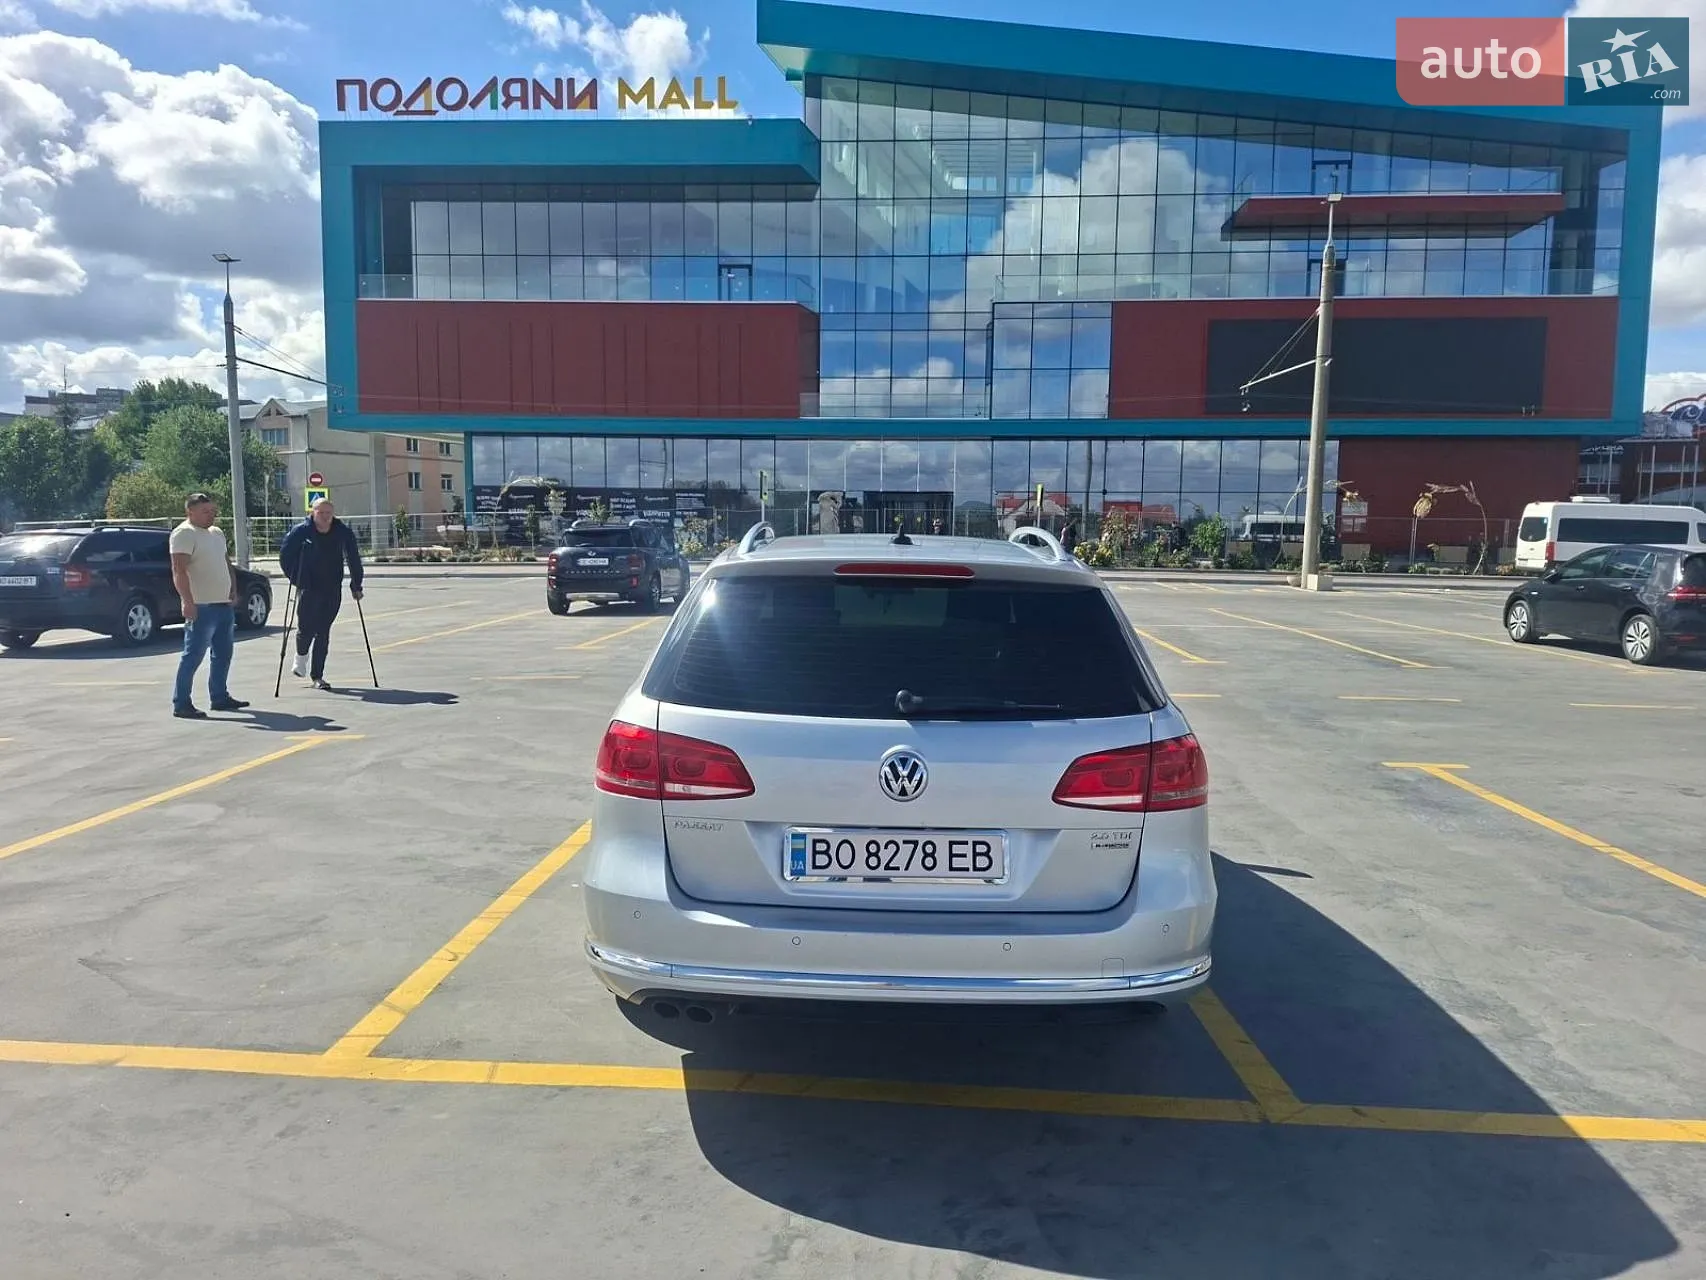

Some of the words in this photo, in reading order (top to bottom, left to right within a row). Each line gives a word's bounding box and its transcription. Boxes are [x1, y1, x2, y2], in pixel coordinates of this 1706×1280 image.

[617, 76, 738, 110] MALL
[790, 861, 806, 870] UA
[811, 838, 856, 870] BO
[865, 839, 938, 871] 8278
[948, 840, 994, 872] EB
